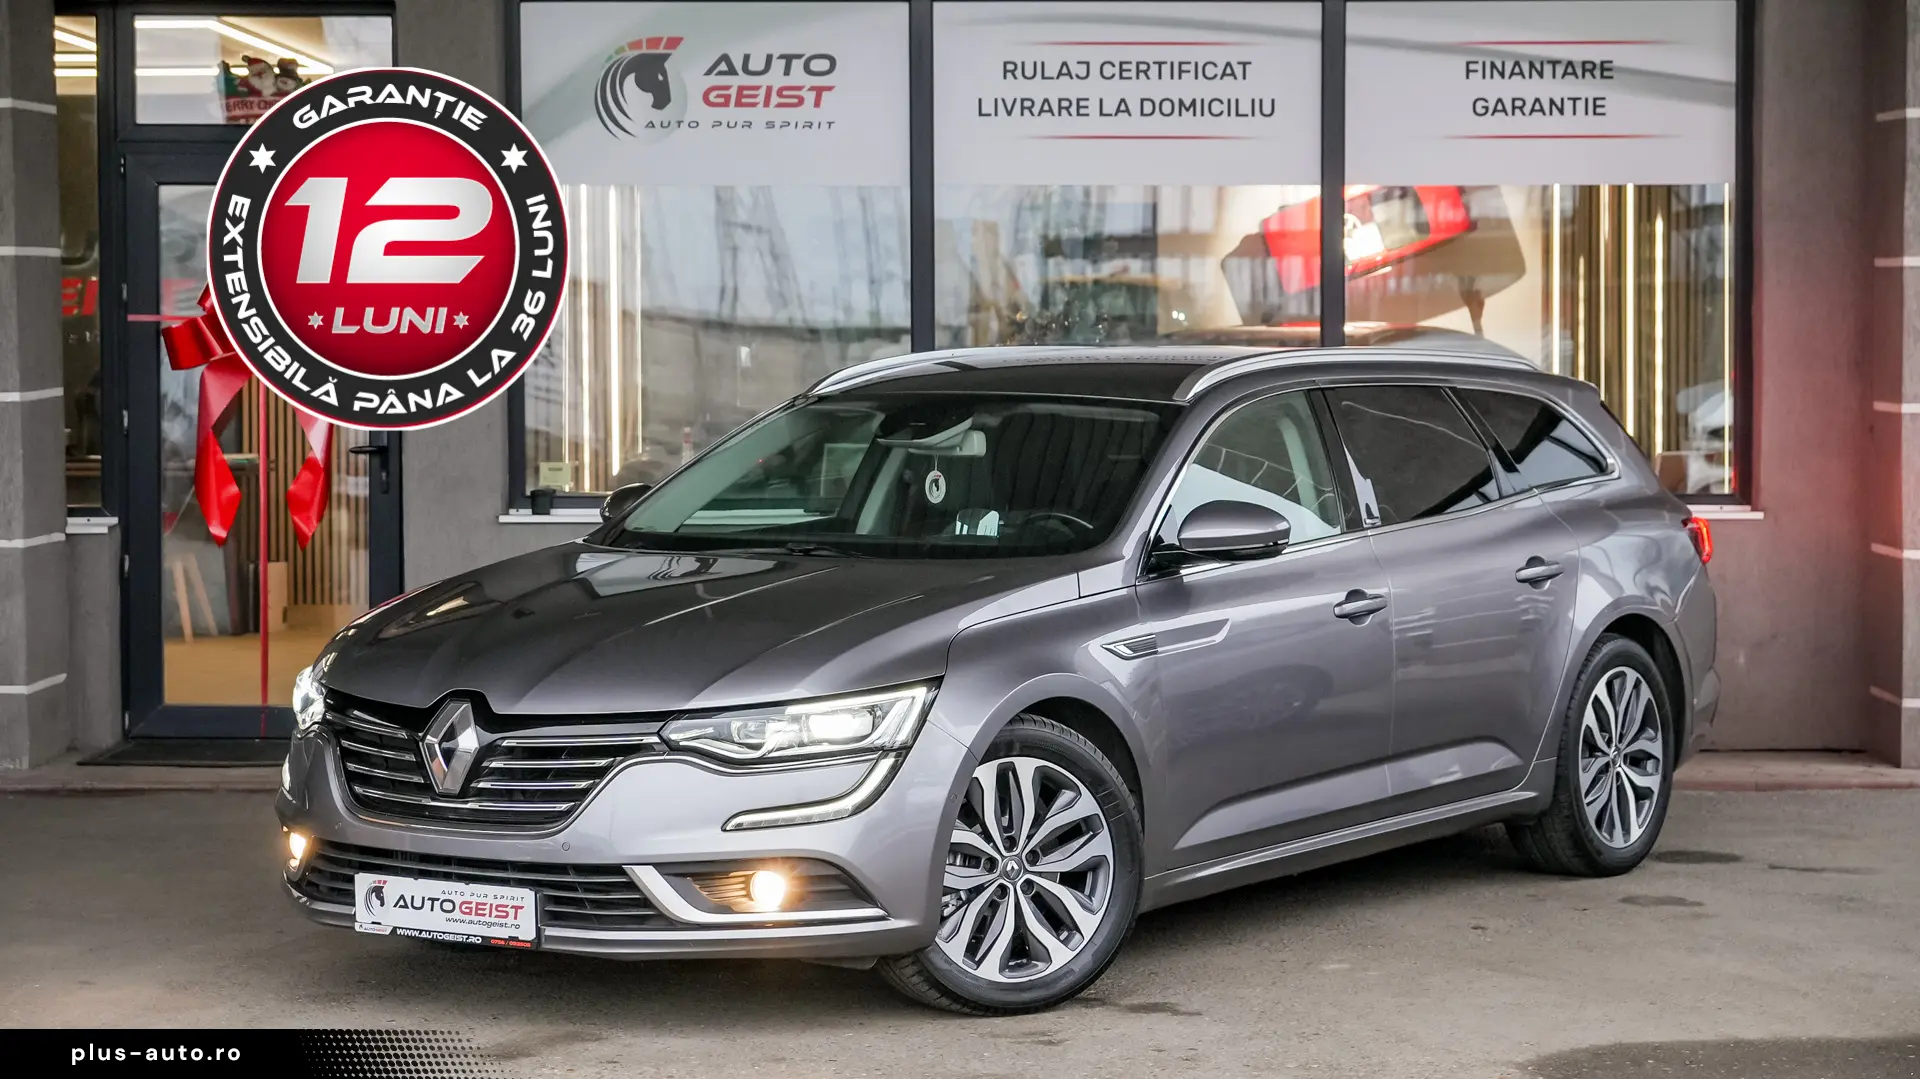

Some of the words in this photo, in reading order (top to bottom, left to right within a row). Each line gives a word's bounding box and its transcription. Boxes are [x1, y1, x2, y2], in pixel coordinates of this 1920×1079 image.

[703, 53, 837, 76] AUTO
[1002, 61, 1091, 80] RULAJ
[1099, 61, 1252, 80] CERTIFICAT
[1465, 60, 1614, 79] FINANTARE
[702, 85, 836, 108] GEIST
[978, 98, 1090, 117] LIVRARE
[1099, 98, 1132, 117] LA
[1140, 98, 1276, 117] DOMICILIU
[1472, 97, 1607, 117] GARANTIE
[645, 120, 700, 129] AUTO
[711, 120, 752, 129] PUR
[766, 120, 836, 130] SPIRIT
[440, 889, 465, 897] AUTO
[445, 917, 521, 929] www.autogeist.ro
[396, 928, 482, 943] WWW.AUTOGEIST.RO
